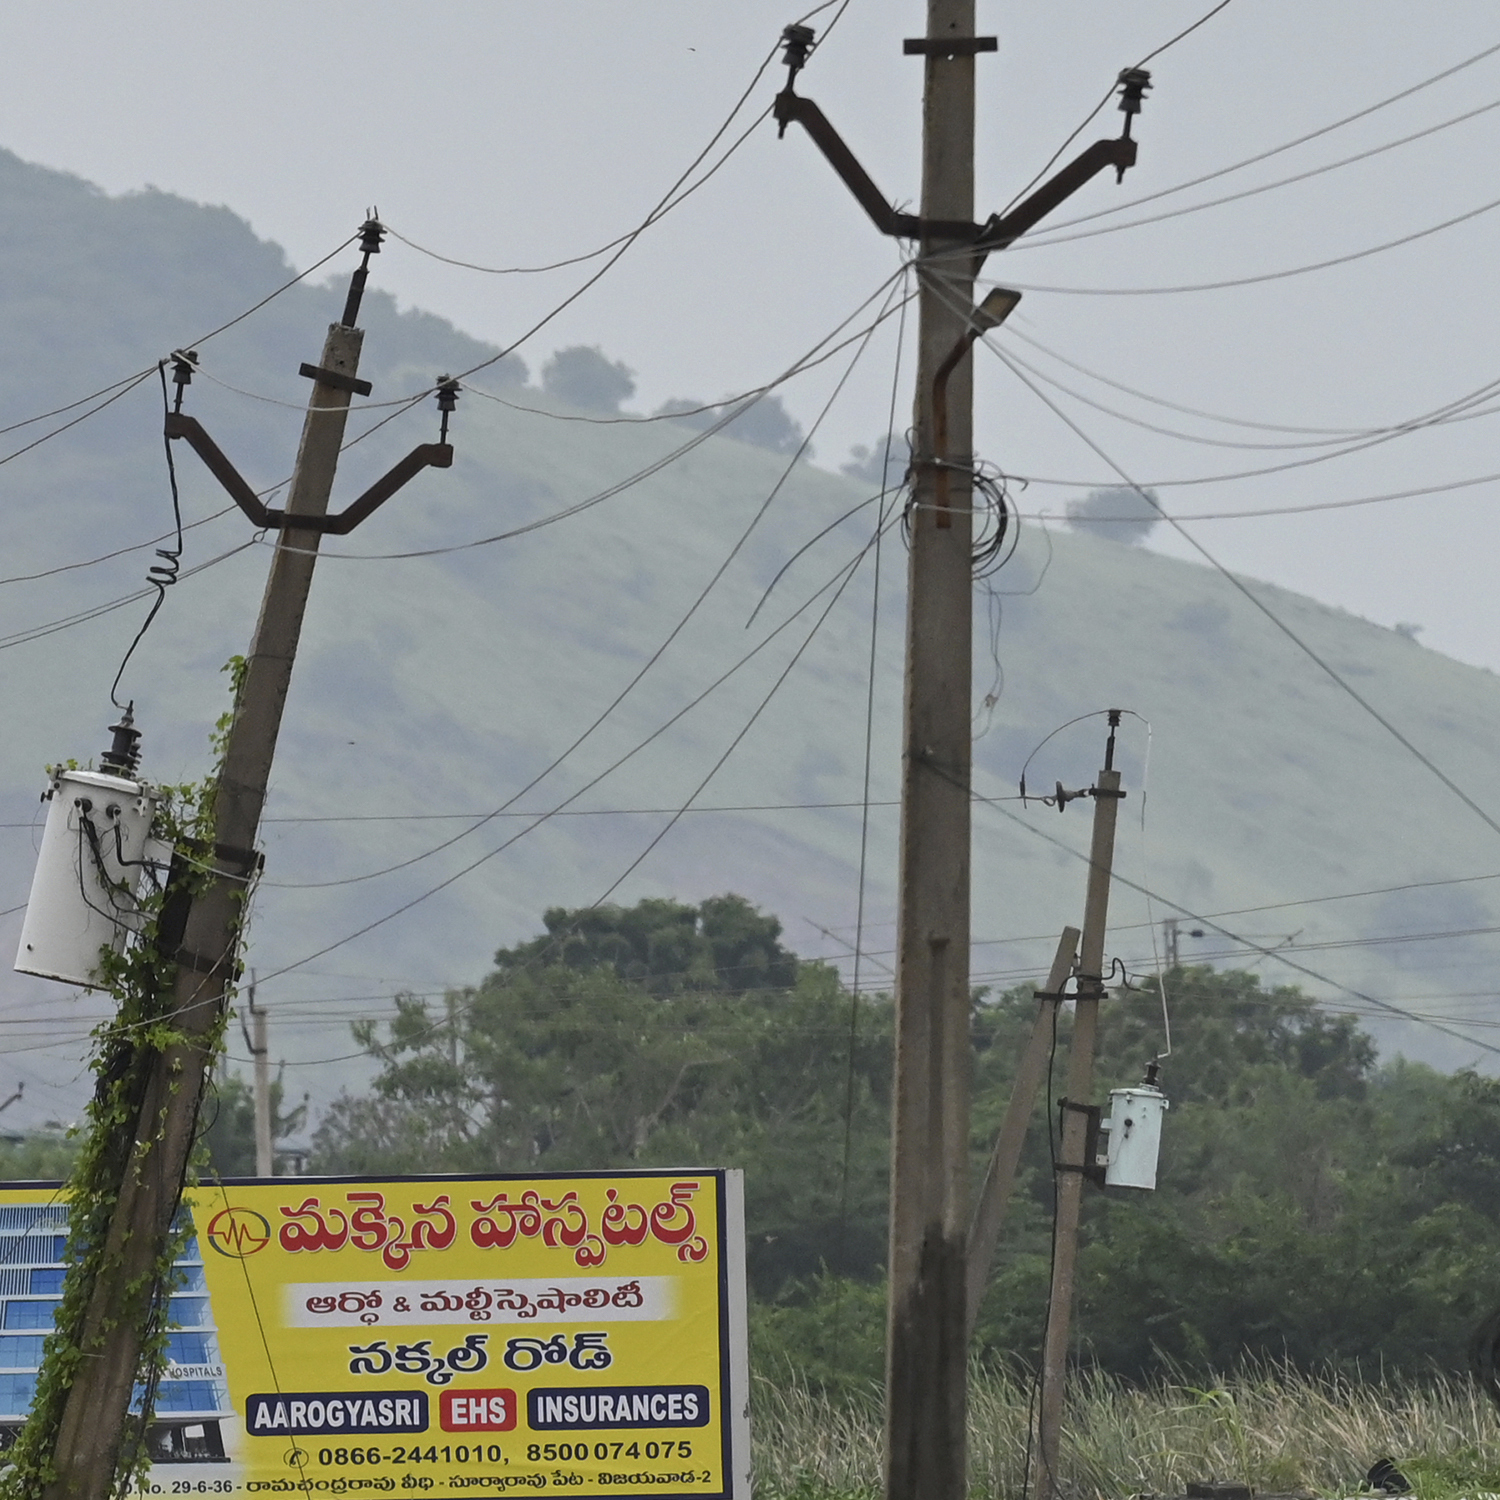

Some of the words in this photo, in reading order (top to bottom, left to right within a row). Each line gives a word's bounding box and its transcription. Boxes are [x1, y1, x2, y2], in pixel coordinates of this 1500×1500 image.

[279, 1191, 457, 1271] మక్కెన
[470, 1182, 709, 1268] హాస్పటల్స్
[393, 1297, 411, 1312] &
[349, 1334, 490, 1384] నక్కల్
[503, 1331, 614, 1373] రోడ్
[254, 1397, 420, 1429] AAROGYASRI
[450, 1397, 506, 1425] EHS
[537, 1393, 699, 1423] INSURANCES
[318, 1444, 510, 1466] 0866-2441010,
[172, 1480, 233, 1494] 29-6-36
[552, 1472, 584, 1487] పేట
